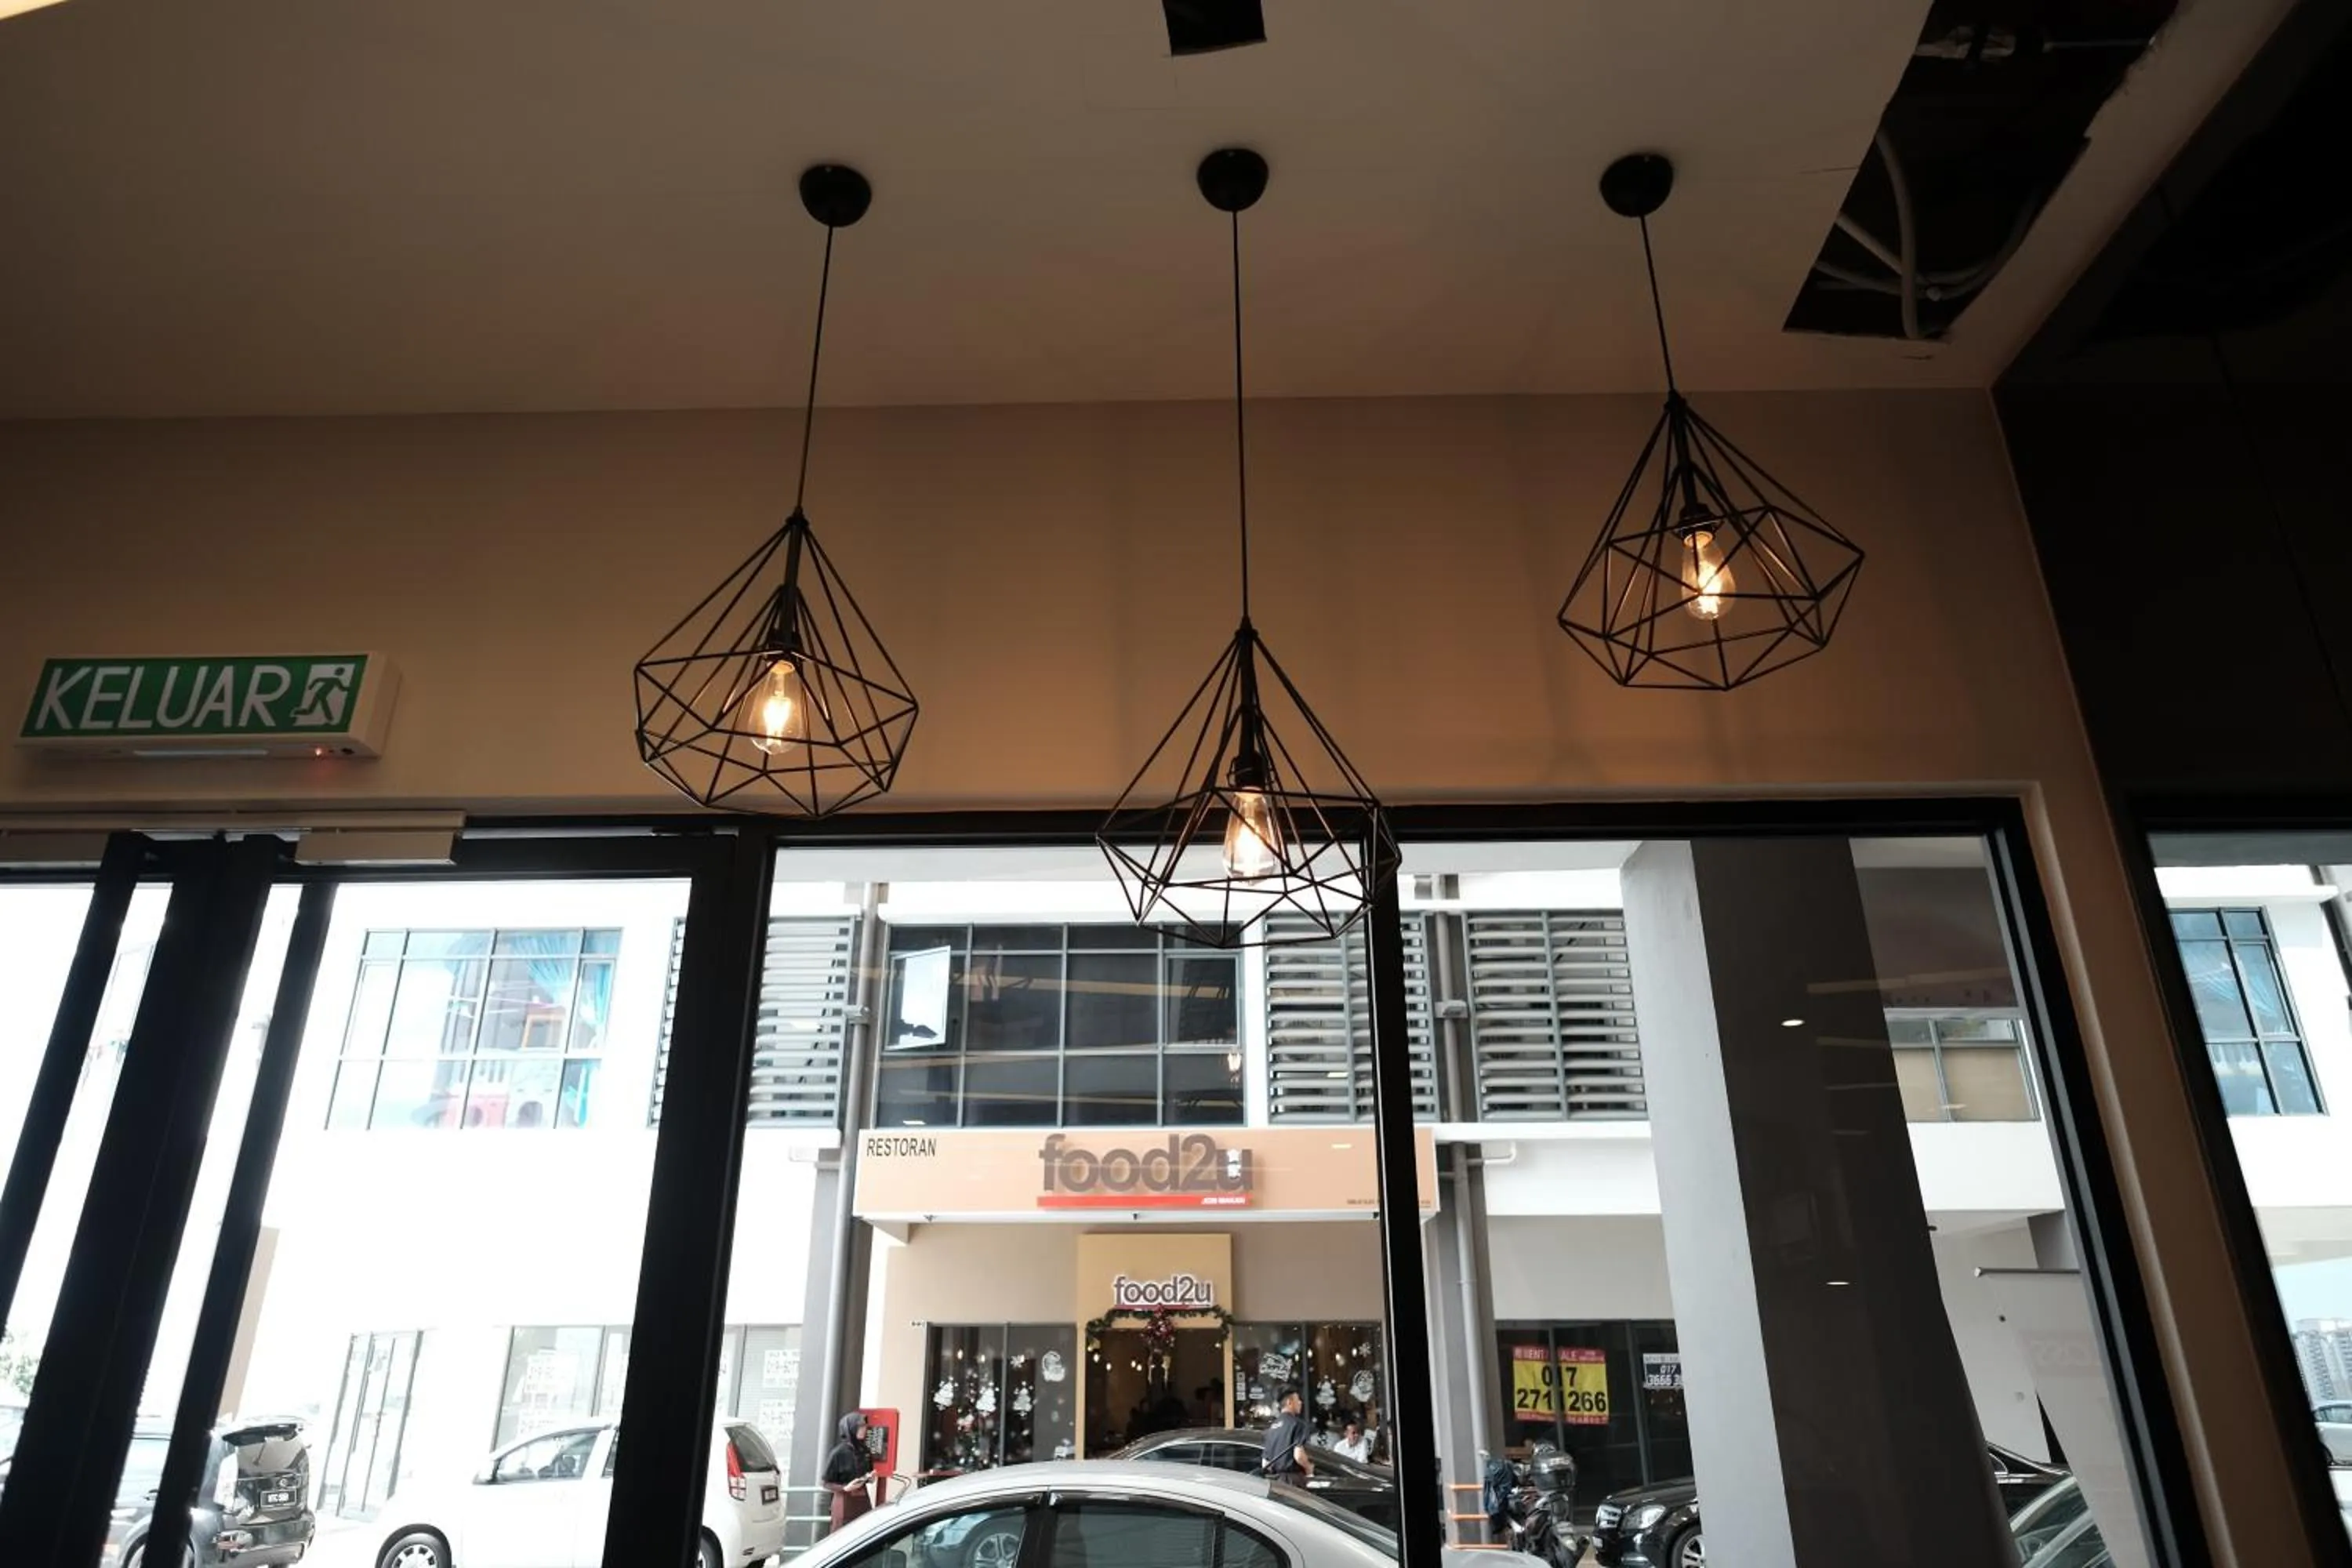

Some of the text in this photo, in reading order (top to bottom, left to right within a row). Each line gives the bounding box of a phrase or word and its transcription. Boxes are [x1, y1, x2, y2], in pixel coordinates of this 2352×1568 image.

[34, 665, 292, 730] KELUAR
[867, 1138, 936, 1157] RESTORAN
[1039, 1134, 1253, 1192] food2u
[1114, 1275, 1212, 1305] food2u
